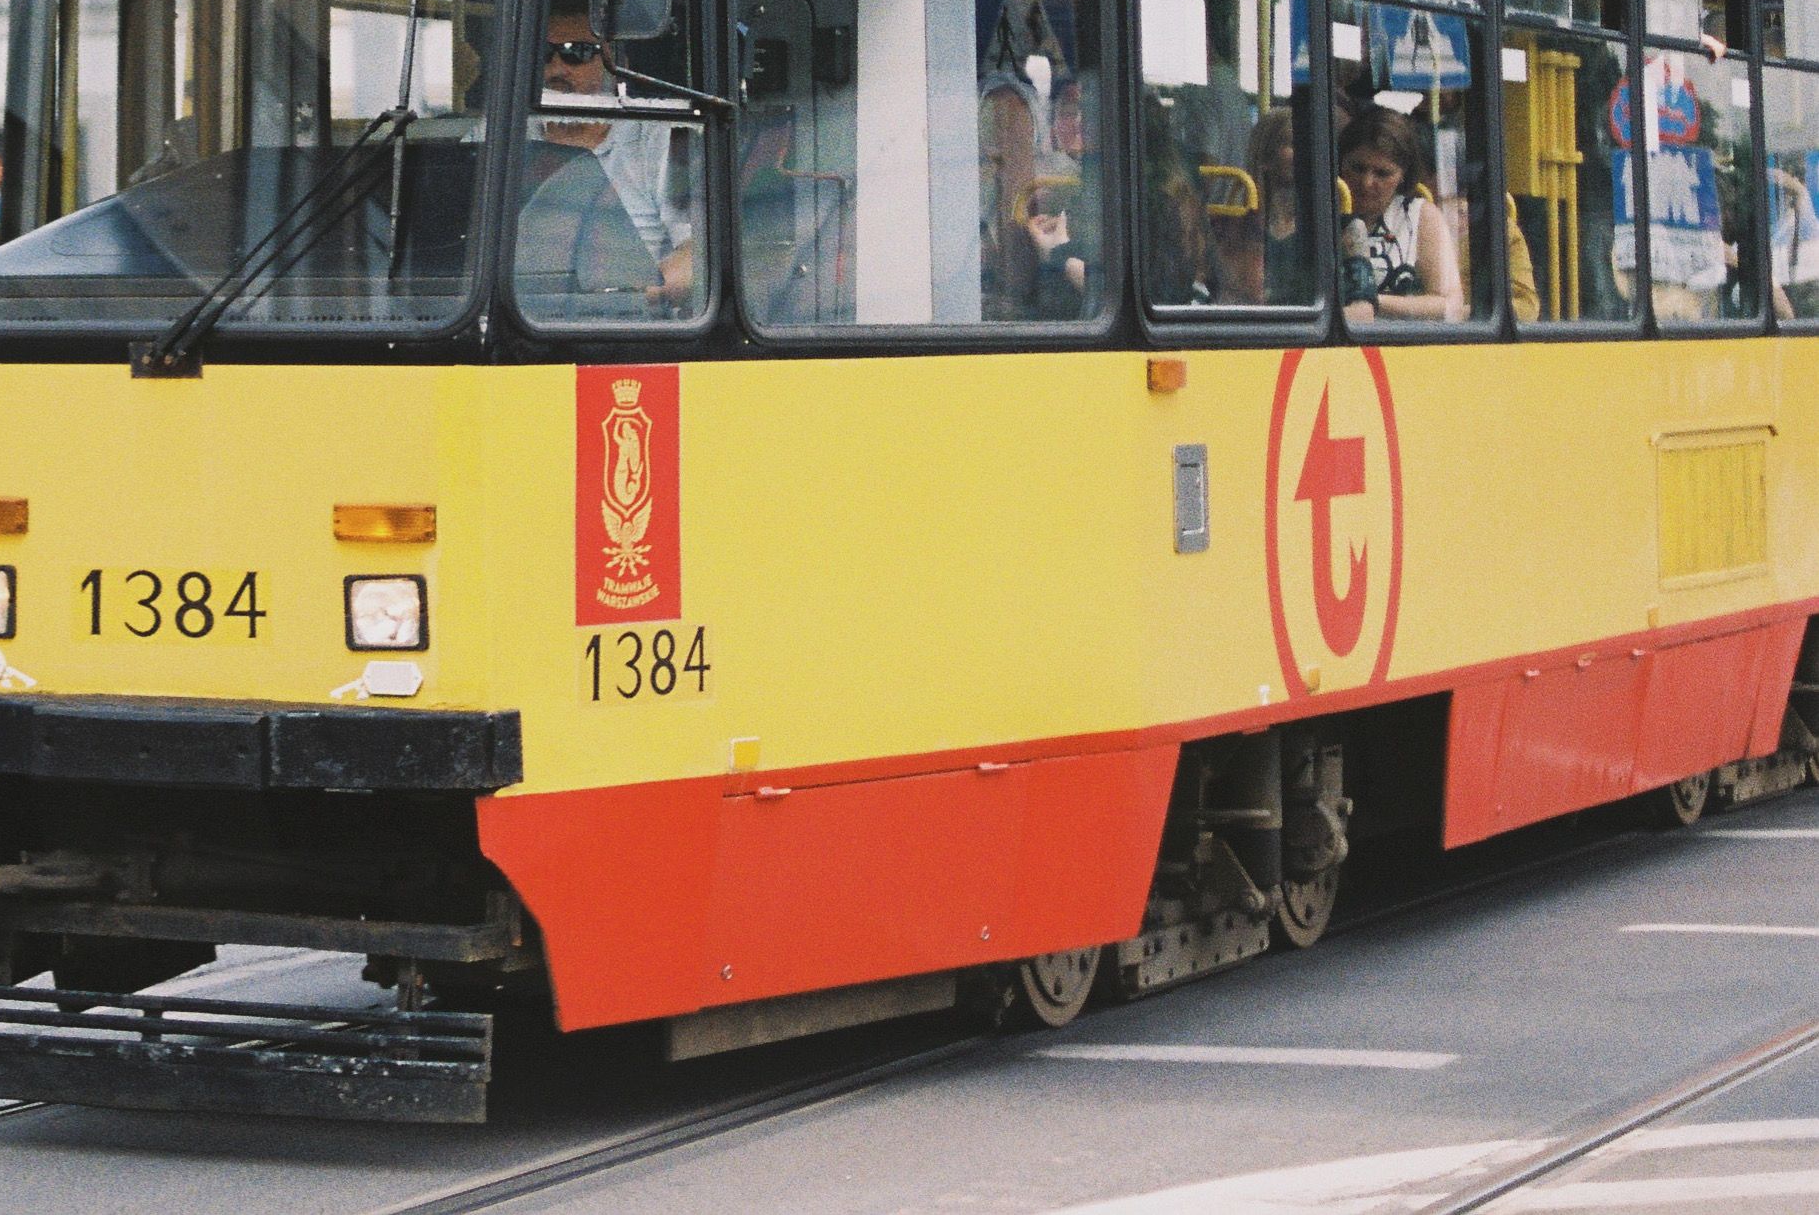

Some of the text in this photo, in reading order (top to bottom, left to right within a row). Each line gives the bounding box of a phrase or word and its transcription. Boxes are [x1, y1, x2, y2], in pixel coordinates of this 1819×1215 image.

[81, 569, 267, 638] 1384
[603, 573, 653, 595] TRAMWAJE
[585, 626, 711, 701] 1384
